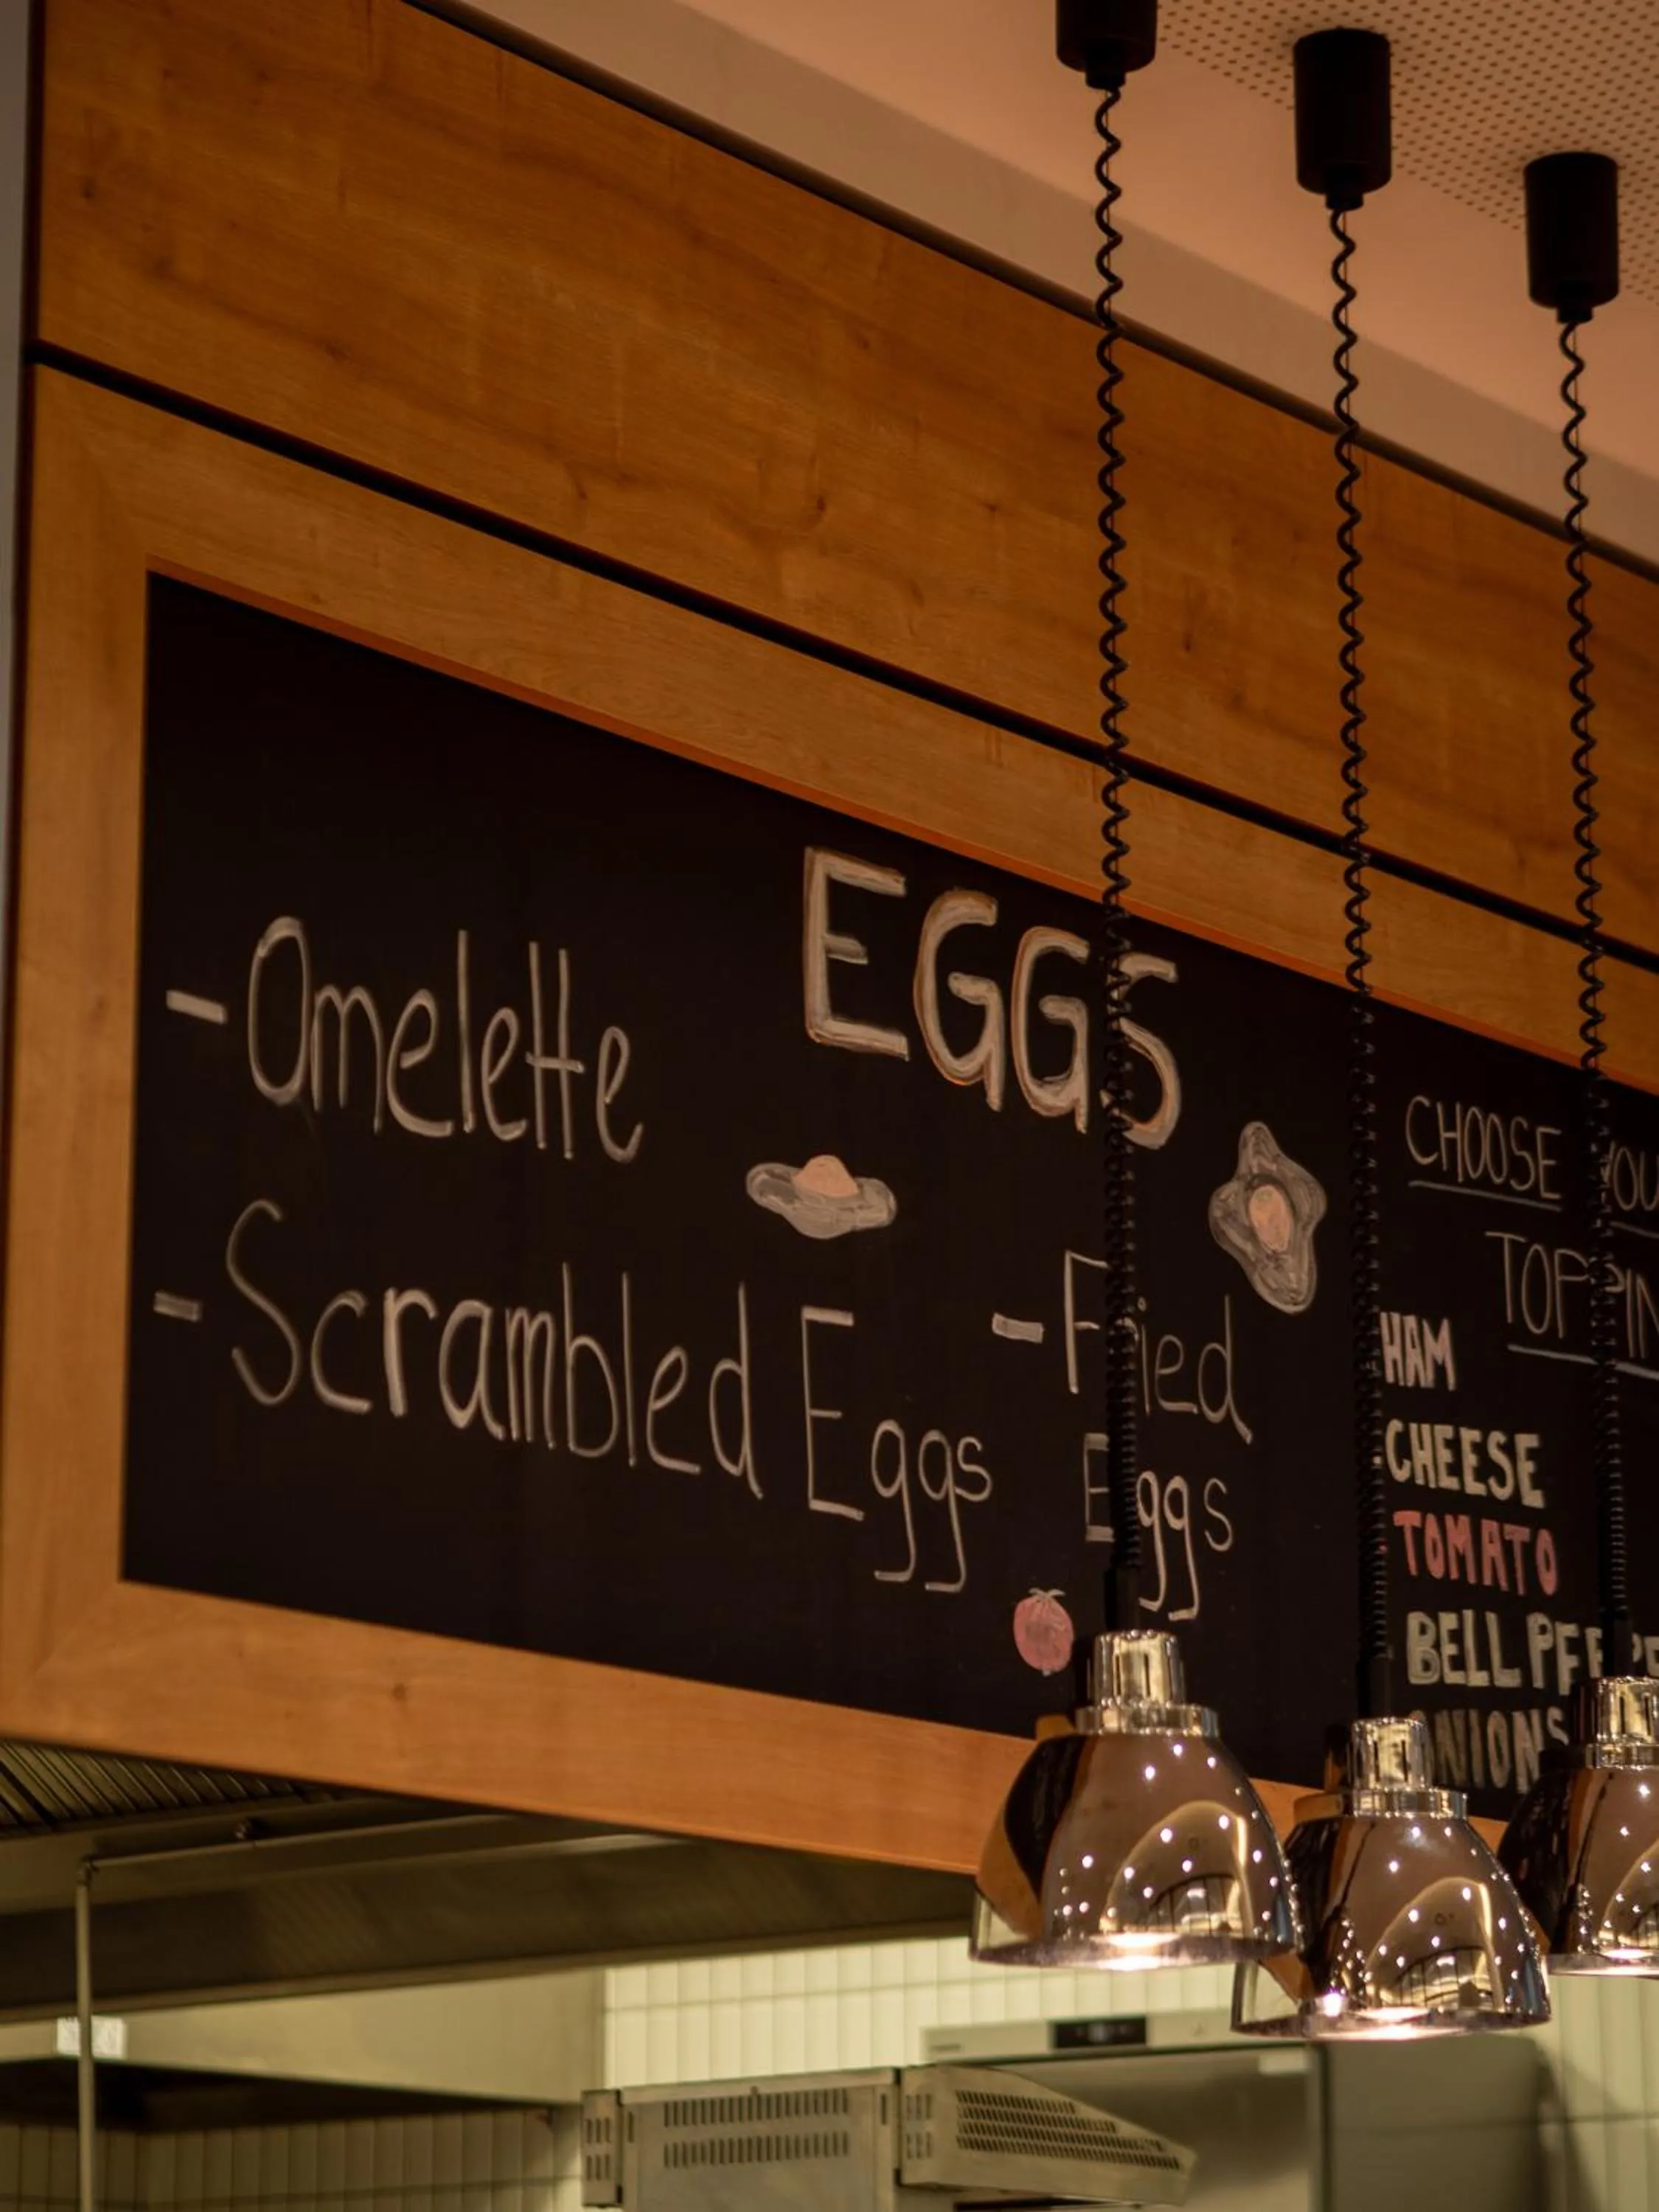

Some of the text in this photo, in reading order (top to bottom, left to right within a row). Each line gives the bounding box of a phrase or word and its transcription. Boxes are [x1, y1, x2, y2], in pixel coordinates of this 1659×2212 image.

[248, 915, 644, 1164] Omelette
[802, 846, 1181, 1150] EGGS
[1405, 1095, 1562, 1200] CHOOSE
[226, 1199, 763, 1500] Scrambled
[801, 1306, 992, 1593] Eggs
[1379, 1311, 1458, 1392] HAM
[1385, 1418, 1546, 1509] CHEESE
[1082, 1433, 1234, 1621] Eggs
[1393, 1510, 1559, 1597] TOMATO
[1405, 1609, 1522, 1688] BELL
